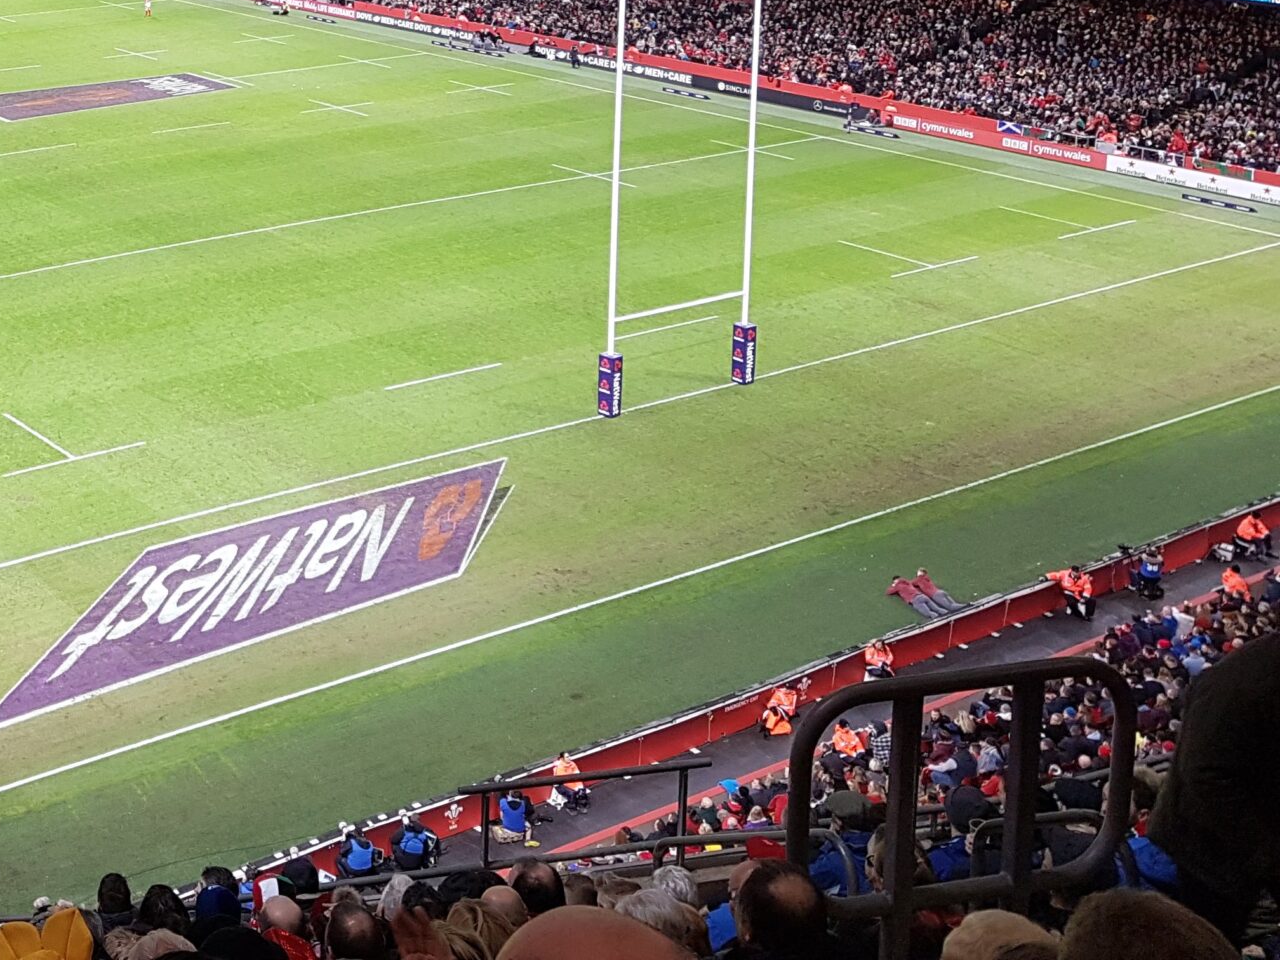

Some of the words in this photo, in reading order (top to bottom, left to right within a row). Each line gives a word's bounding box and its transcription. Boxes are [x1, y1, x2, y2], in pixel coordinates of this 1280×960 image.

[328, 5, 354, 18] INSURANCE
[356, 11, 373, 21] DOVE
[381, 16, 414, 30] MEN+CARE
[415, 23, 432, 33] DOVE
[535, 46, 556, 56] DOVE
[644, 68, 692, 84] MEN+CARE
[726, 85, 751, 94] SINCLAI
[894, 117, 916, 128] BBC
[922, 122, 949, 136] cymru
[950, 126, 974, 139] wales
[1003, 138, 1028, 151] BBC
[1033, 144, 1063, 158] cymru
[1063, 149, 1091, 163] wales
[1116, 167, 1146, 178] Heineken
[1156, 174, 1186, 186] Heineken
[1197, 182, 1228, 194] Heineken
[745, 342, 754, 384] NatWest
[47, 497, 415, 682] NatWest
